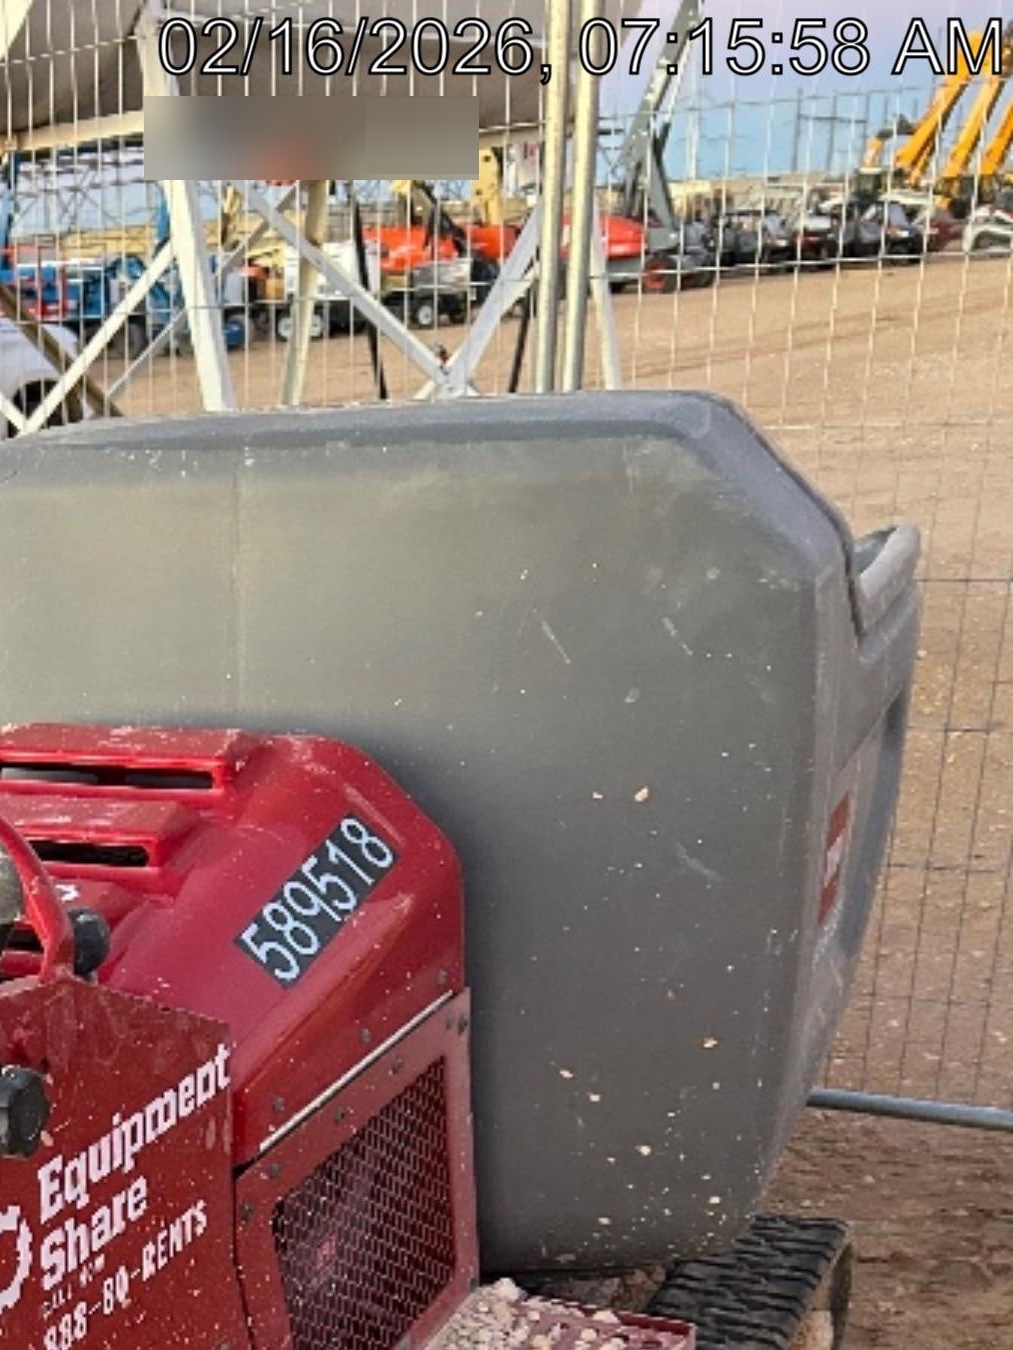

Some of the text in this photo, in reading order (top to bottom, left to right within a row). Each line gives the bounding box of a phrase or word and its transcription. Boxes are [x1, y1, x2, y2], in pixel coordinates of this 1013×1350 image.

[241, 818, 393, 981] 589518
[37, 1043, 231, 1226] Equipment
[40, 1175, 148, 1292] Share
